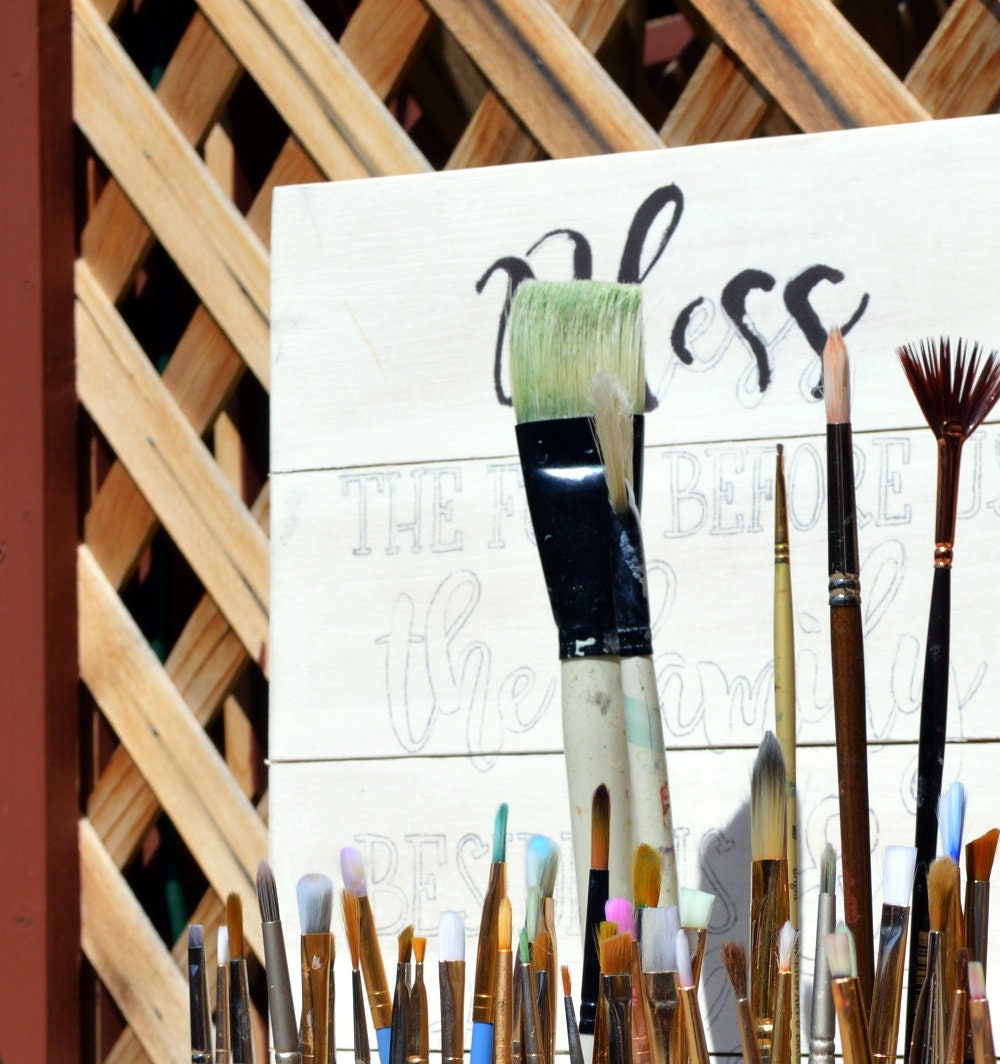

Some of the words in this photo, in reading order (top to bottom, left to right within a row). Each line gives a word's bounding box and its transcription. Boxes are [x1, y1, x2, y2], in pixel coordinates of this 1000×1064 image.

[339, 466, 462, 556] THE
[374, 569, 557, 773] the
[646, 539, 988, 816] amily
